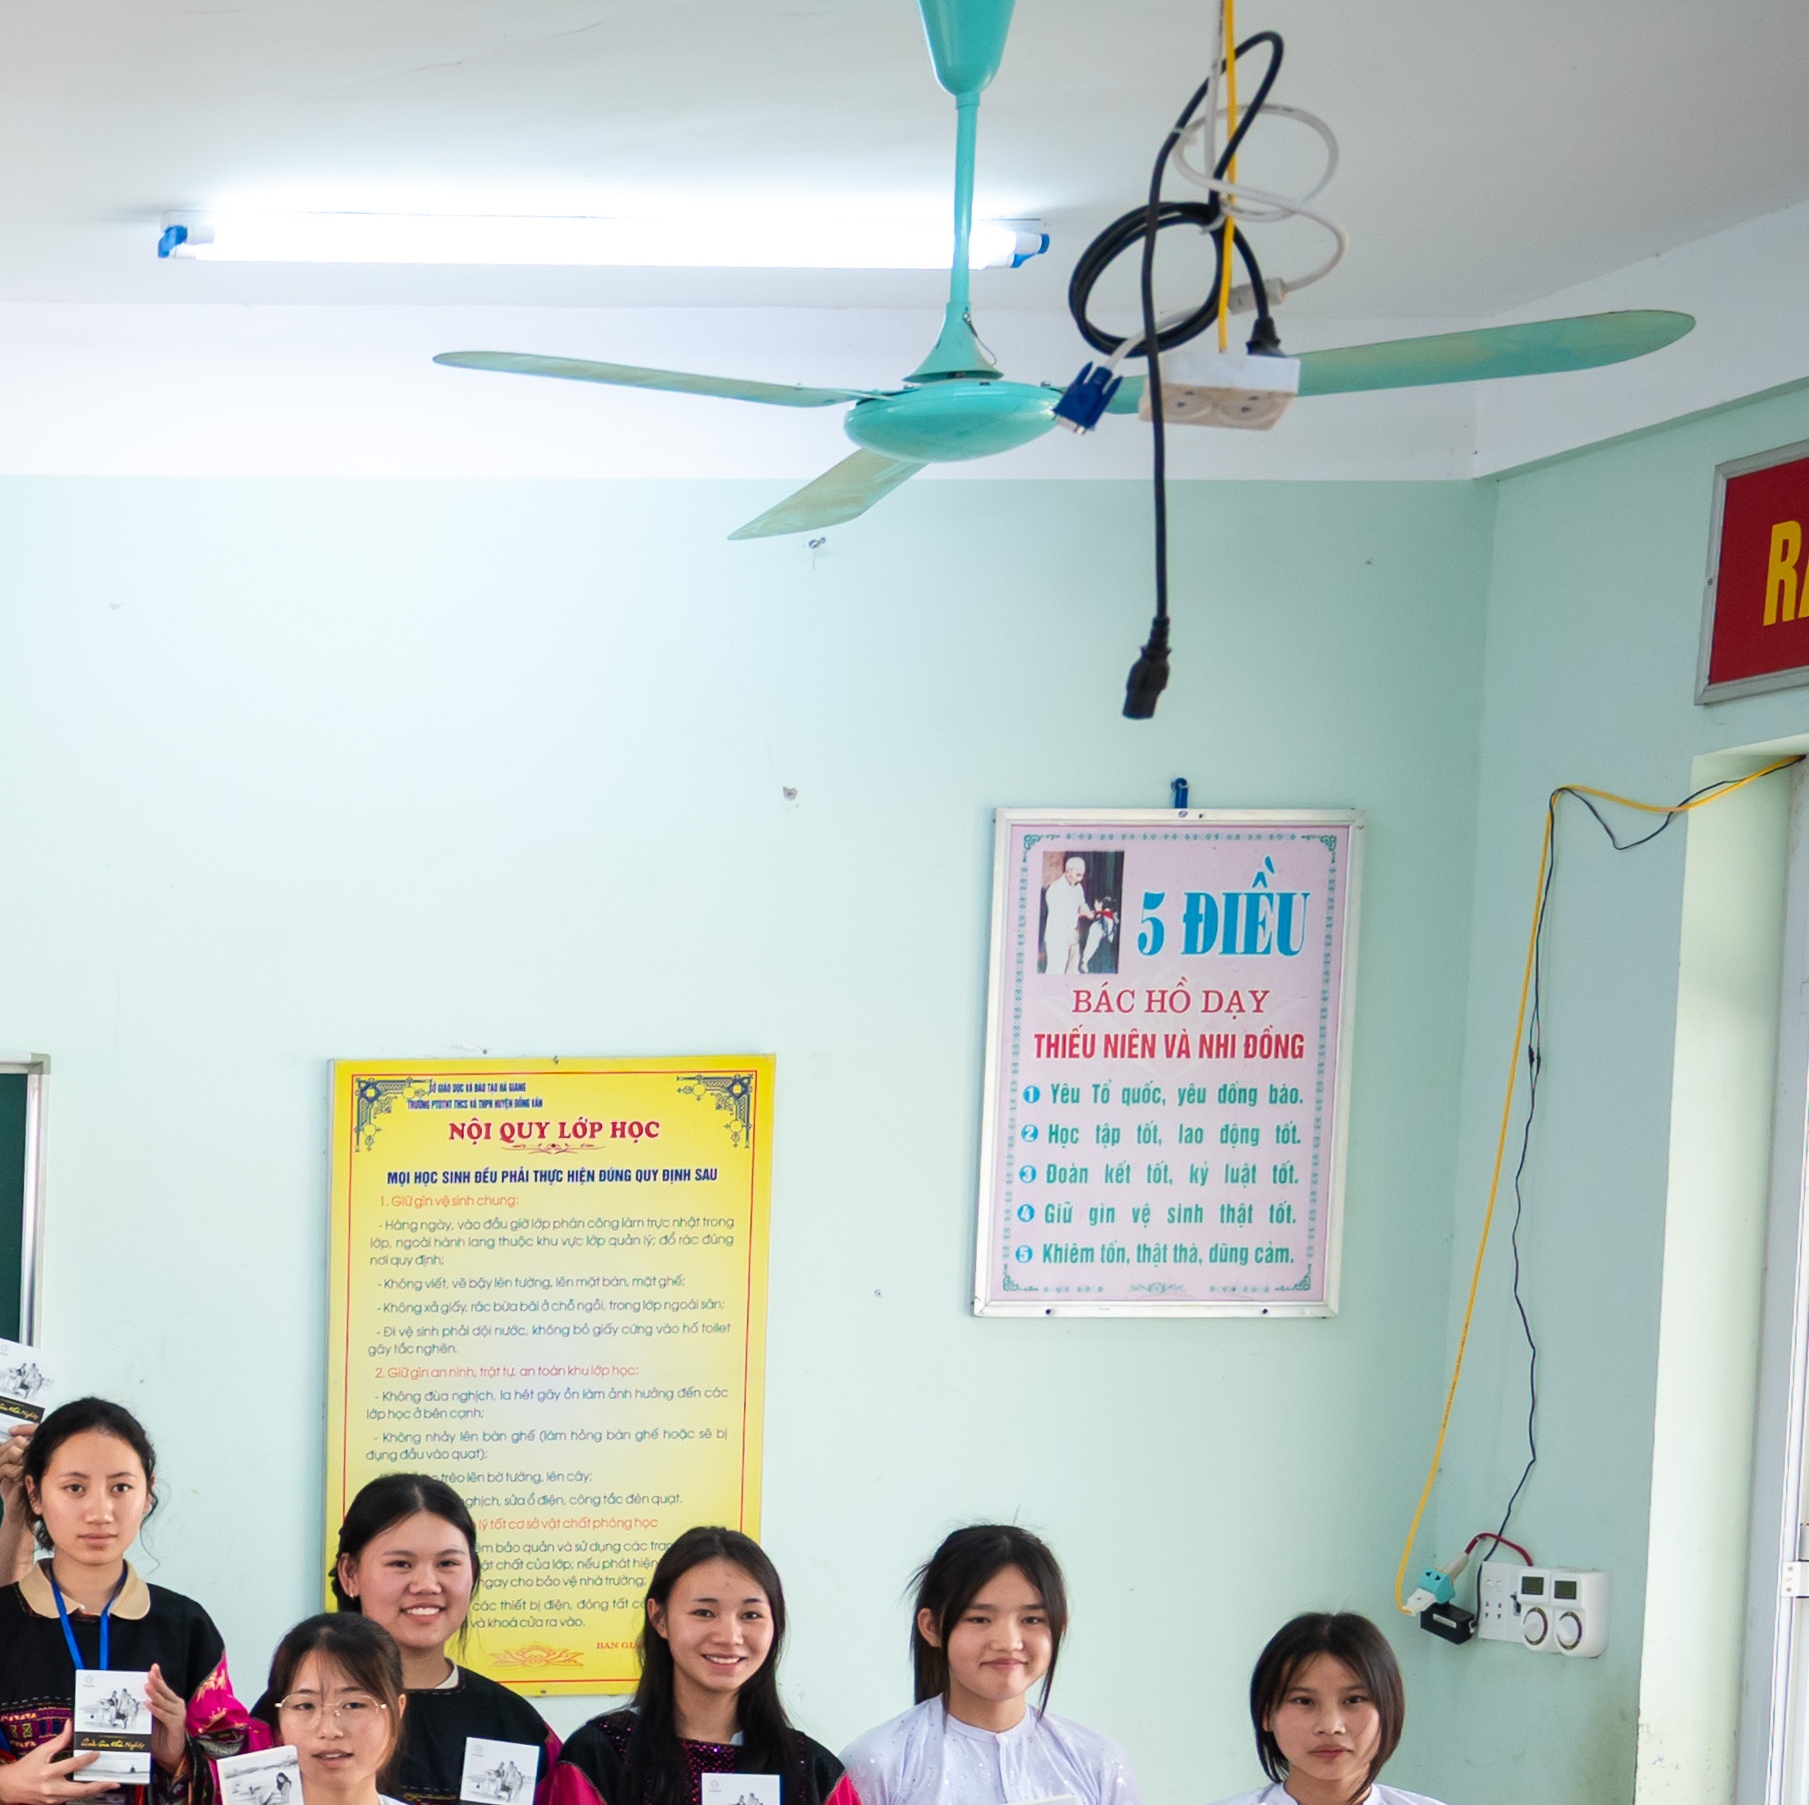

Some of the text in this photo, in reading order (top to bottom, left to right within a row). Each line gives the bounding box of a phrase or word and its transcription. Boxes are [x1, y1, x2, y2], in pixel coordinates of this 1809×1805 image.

[1763, 520, 1809, 626] R
[1136, 856, 1310, 958] 5 ĐIỀU
[1071, 976, 1271, 1021] BÁC HỒ DẠY
[1033, 1024, 1305, 1061] THIẾU NIÊN VÀ NHI ĐỒNG
[1050, 1083, 1080, 1104] Yêu
[1092, 1079, 1112, 1104] Tổ
[1121, 1079, 1166, 1107] quốc,
[1177, 1083, 1206, 1106] yêu
[448, 1117, 660, 1144] NỘI QUY LỚP HỌC
[1048, 1123, 1080, 1149] Học
[1095, 1123, 1121, 1149] tập
[1136, 1119, 1162, 1146] tốt,
[1178, 1123, 1204, 1144] lao
[1219, 1123, 1260, 1149] động
[1275, 1120, 1301, 1145] tốt.
[387, 1171, 410, 1188] MỌI
[414, 1171, 438, 1188] HỌC
[442, 1171, 471, 1184] SINH
[501, 1166, 529, 1183] PHẢI
[533, 1170, 563, 1185] THỰC
[567, 1168, 595, 1185] HIỆN
[599, 1166, 632, 1182] ĐÚNG
[635, 1169, 658, 1182] QUY
[662, 1168, 692, 1184] ĐỊNH
[694, 1168, 717, 1181] SAU
[1046, 1162, 1088, 1184] Đoàn
[1104, 1160, 1131, 1184] kết
[1146, 1160, 1173, 1186] tốt,
[1224, 1163, 1257, 1188] luật
[1272, 1160, 1299, 1184] tốt.
[451, 1195, 474, 1206] sinh
[1044, 1201, 1073, 1224] Giữ
[1132, 1203, 1151, 1228] vệ
[1167, 1203, 1203, 1224] sinh
[1219, 1203, 1253, 1228] thật
[1268, 1200, 1296, 1224] tốt.
[1042, 1242, 1094, 1264] Khiêm
[1100, 1239, 1130, 1265] tốn,
[1136, 1242, 1167, 1267] thật
[1209, 1242, 1249, 1265] dũng
[1254, 1240, 1294, 1264] cảm.
[634, 1518, 659, 1529] học
